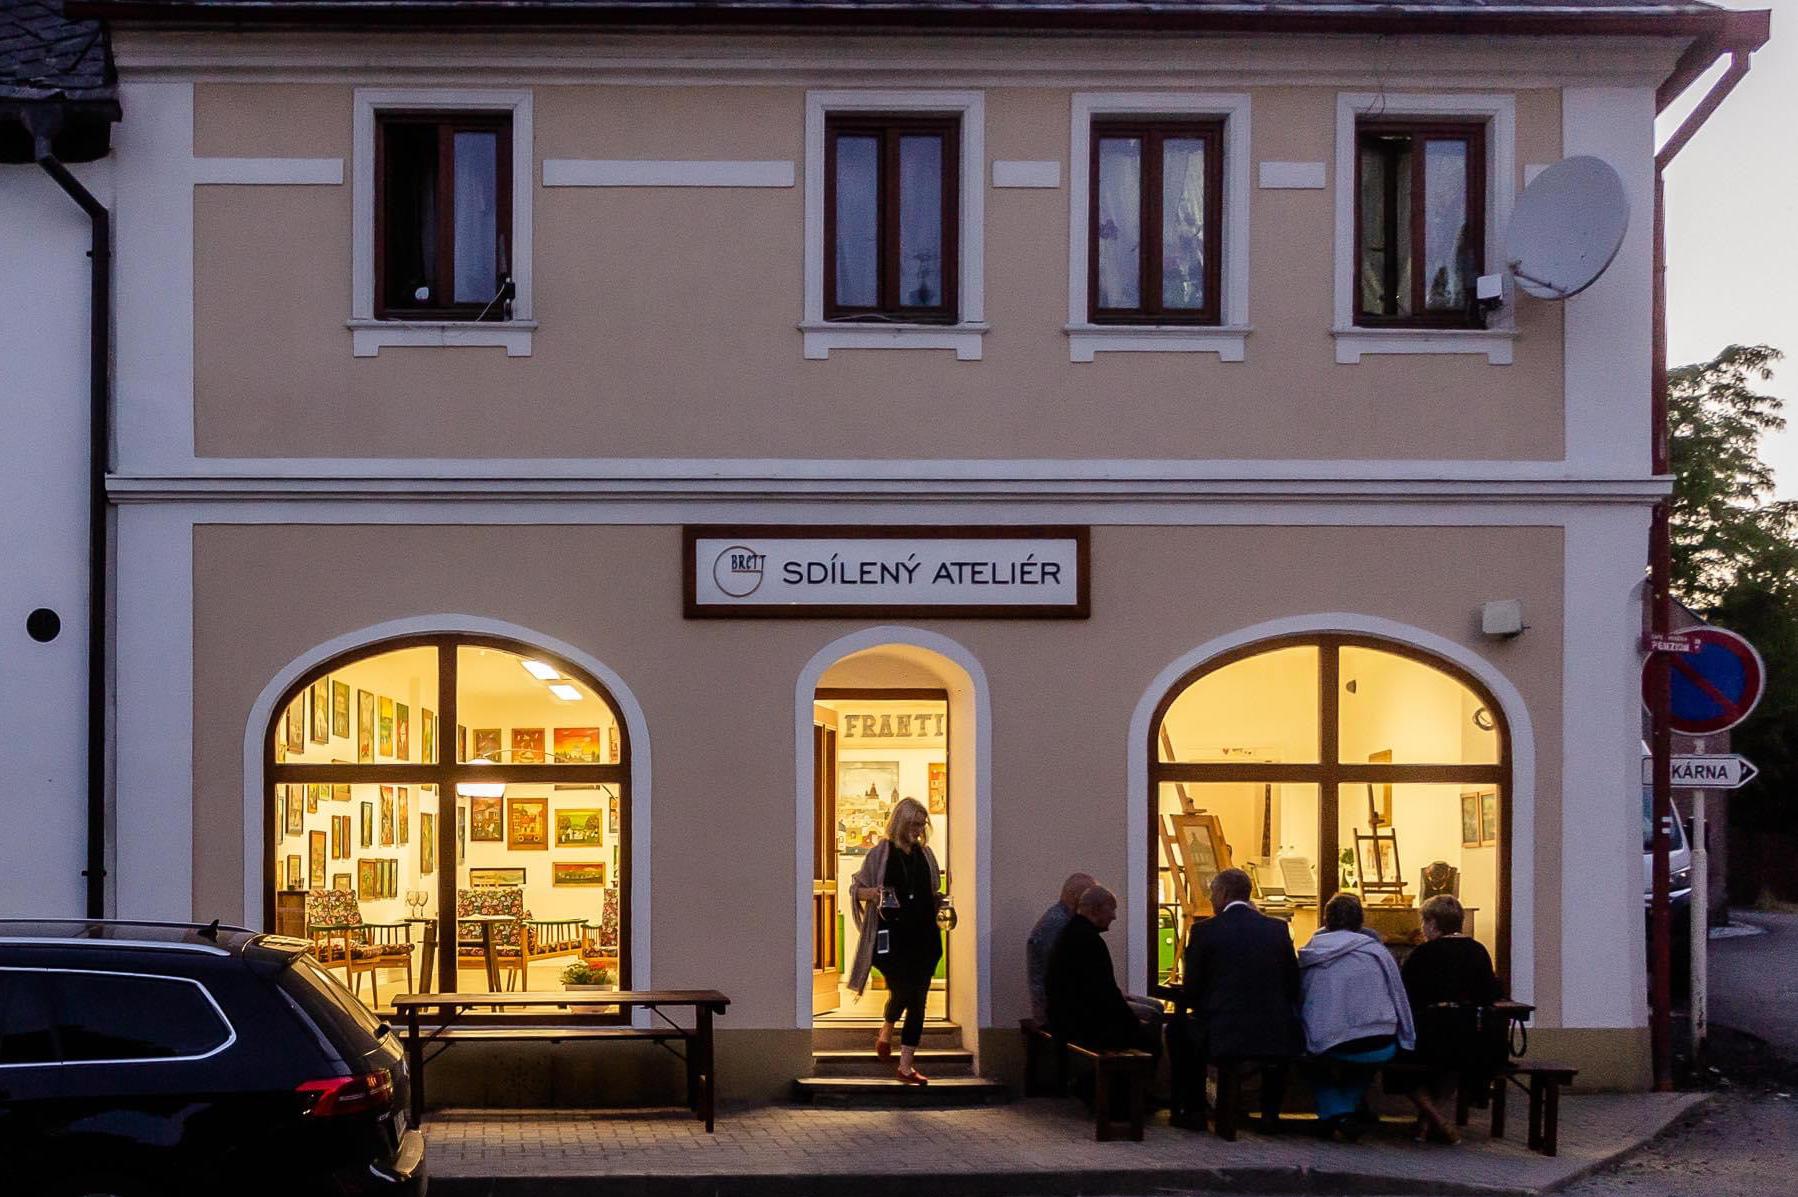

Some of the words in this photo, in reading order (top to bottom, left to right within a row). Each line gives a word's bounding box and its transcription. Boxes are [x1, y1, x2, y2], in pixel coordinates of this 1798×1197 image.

[783, 553, 921, 584] SDÍLENÝ
[932, 553, 1061, 584] ATELIÉR
[1672, 762, 1728, 779] KÁRNA
